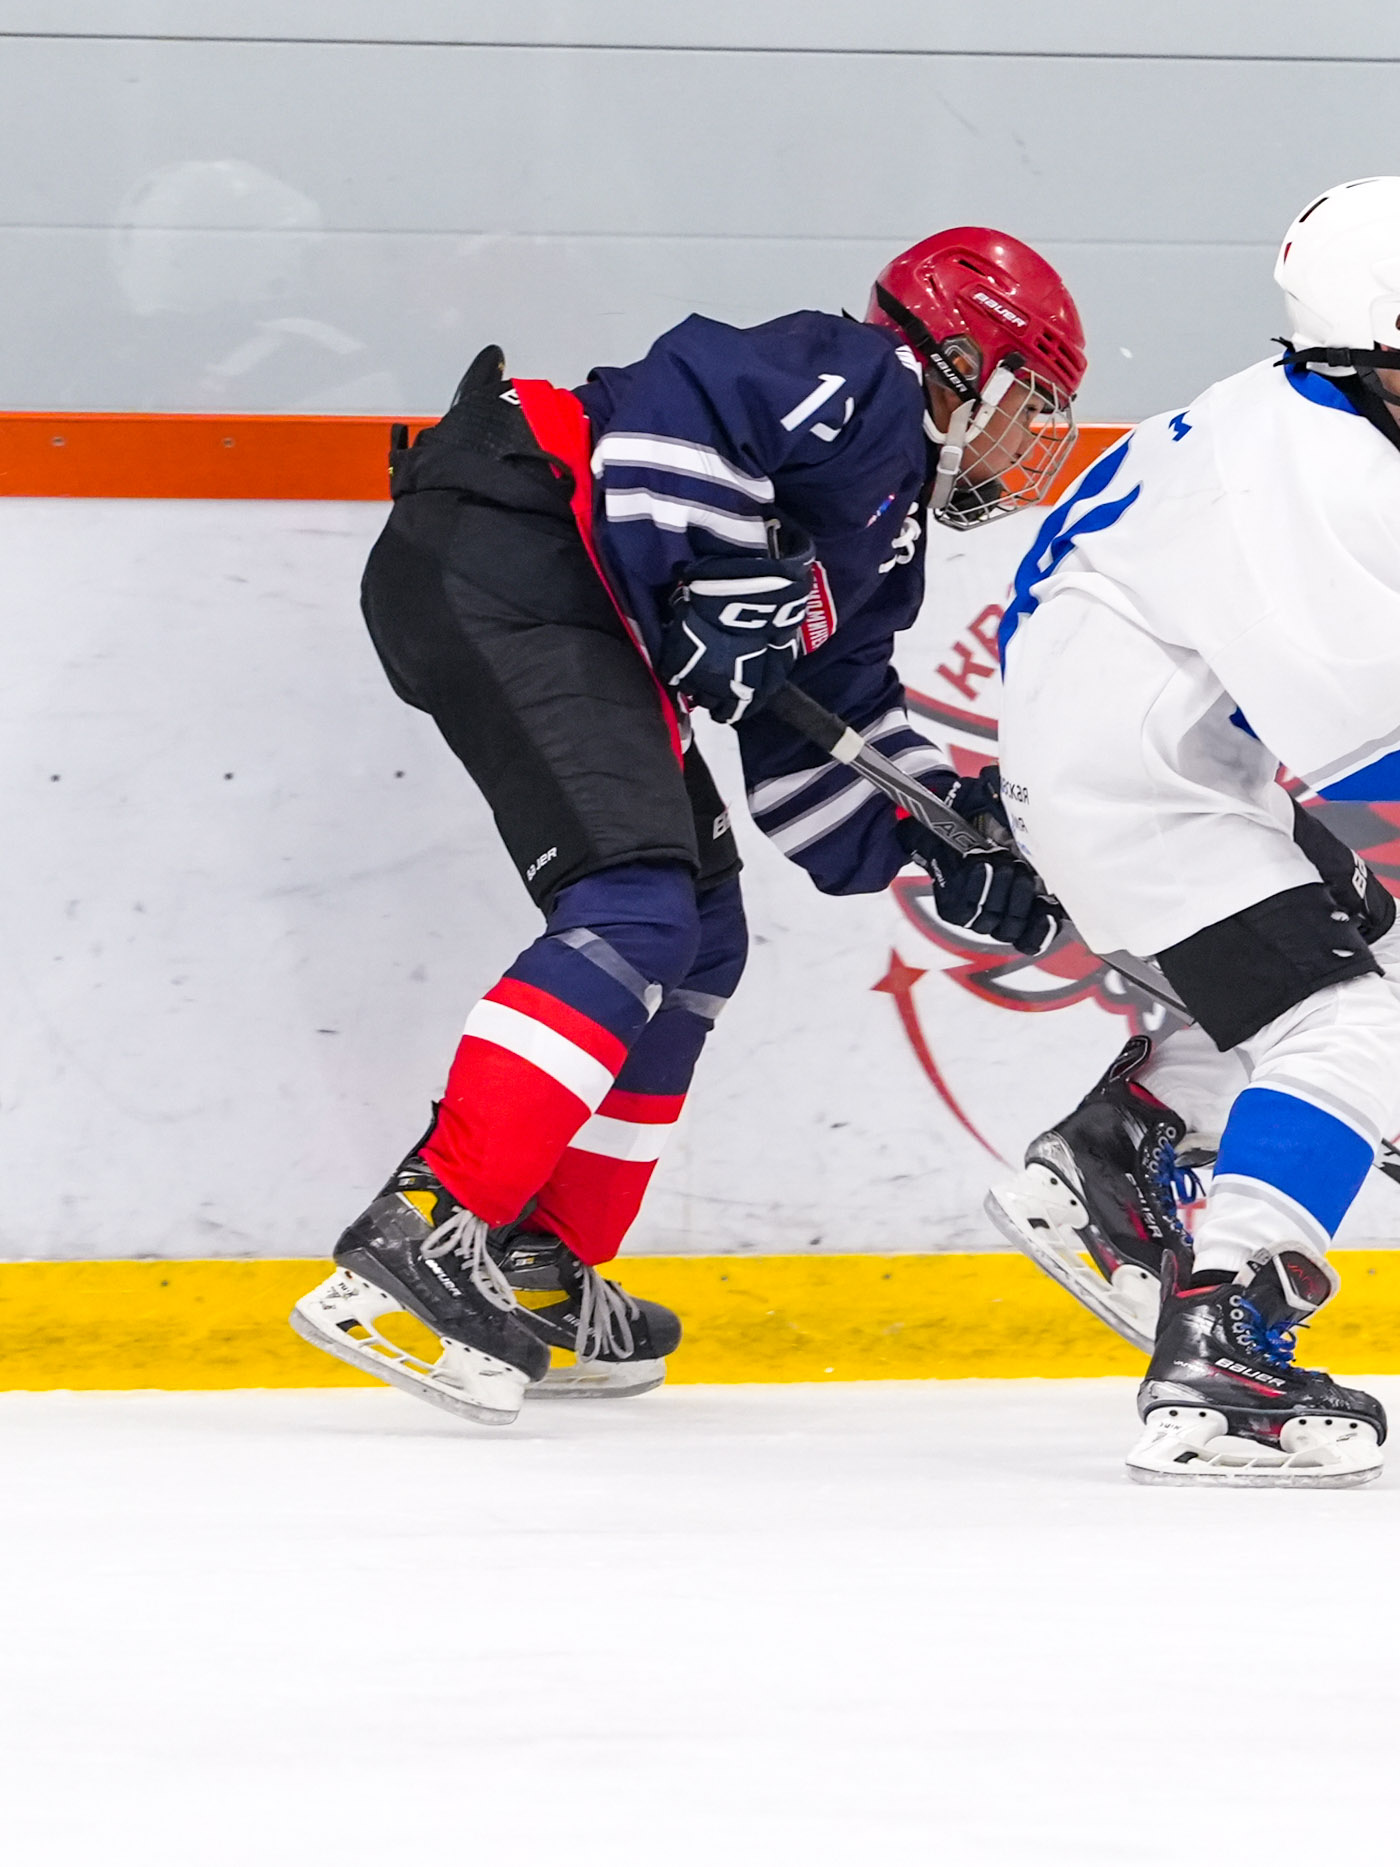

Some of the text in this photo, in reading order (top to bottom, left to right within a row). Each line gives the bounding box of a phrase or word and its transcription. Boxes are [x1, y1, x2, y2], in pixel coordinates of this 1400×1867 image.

[973, 292, 1027, 328] BAUER
[930, 353, 968, 393] BAUER
[934, 603, 1004, 701] КР
[1214, 1356, 1287, 1389] BAUER
